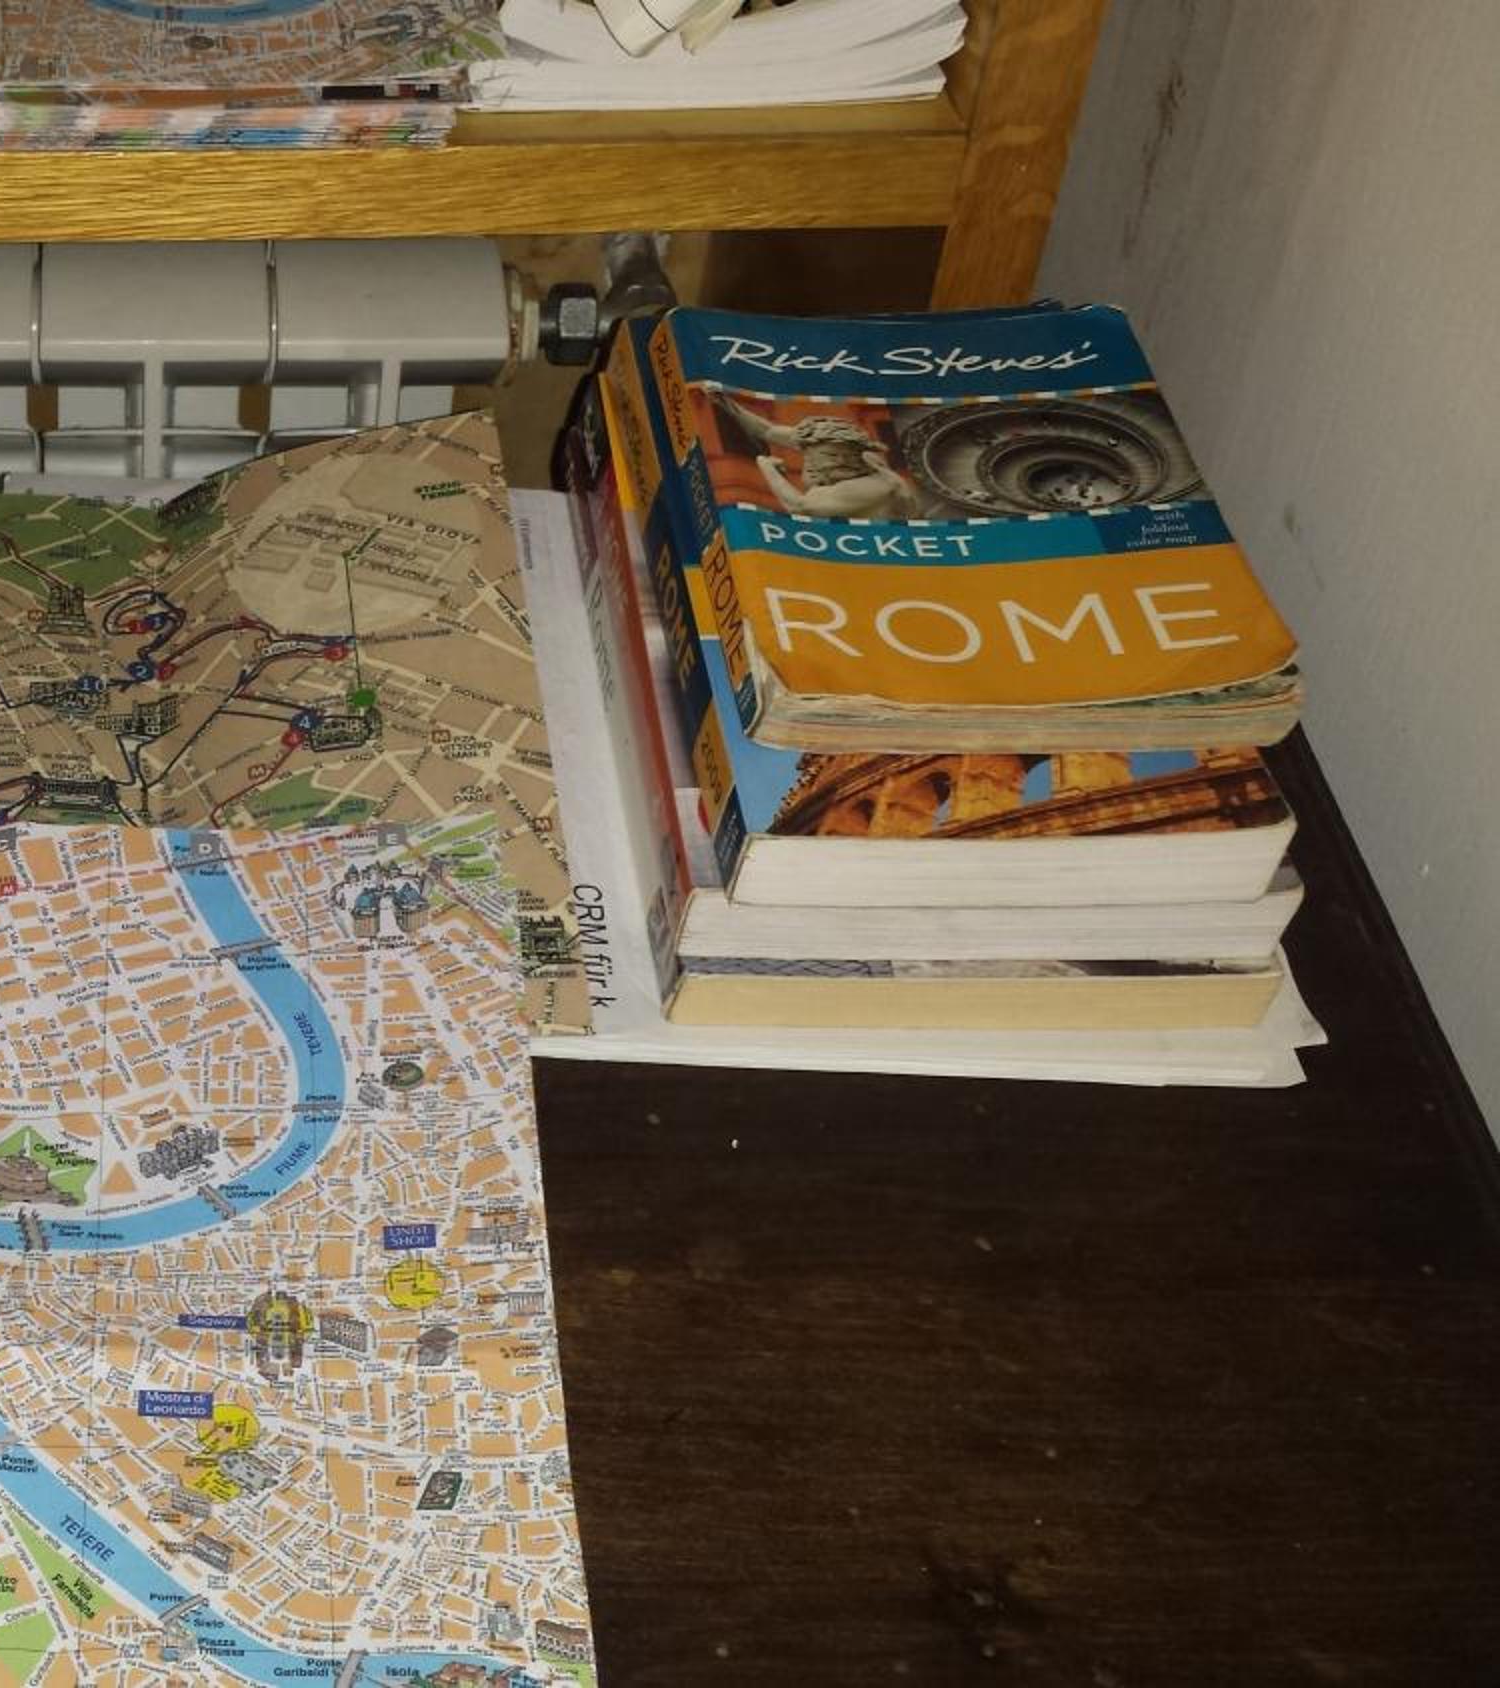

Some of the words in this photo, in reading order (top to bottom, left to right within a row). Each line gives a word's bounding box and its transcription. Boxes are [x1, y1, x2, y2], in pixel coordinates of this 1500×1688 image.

[710, 336, 876, 375] Rick
[880, 342, 1099, 376] Steves'
[760, 523, 974, 558] POCKET
[655, 550, 697, 688] ROME
[706, 548, 745, 677] ROME
[763, 583, 1241, 665] ROME
[700, 730, 725, 805] 2009
[199, 843, 212, 854] D
[387, 833, 398, 844] E
[573, 884, 608, 944] CRM
[582, 954, 613, 988] für
[292, 1011, 323, 1057] TEVERE
[275, 1141, 312, 1177] FIUME
[390, 1236, 429, 1246] SHOP
[189, 1317, 238, 1327] Segway
[144, 1404, 208, 1416] Leonardo
[145, 1391, 191, 1404] Mostra
[1, 1453, 35, 1466] Ponte
[57, 1513, 117, 1563] TEVERE
[274, 1668, 330, 1677] Garibaldi
[306, 1658, 343, 1667] Ponte
